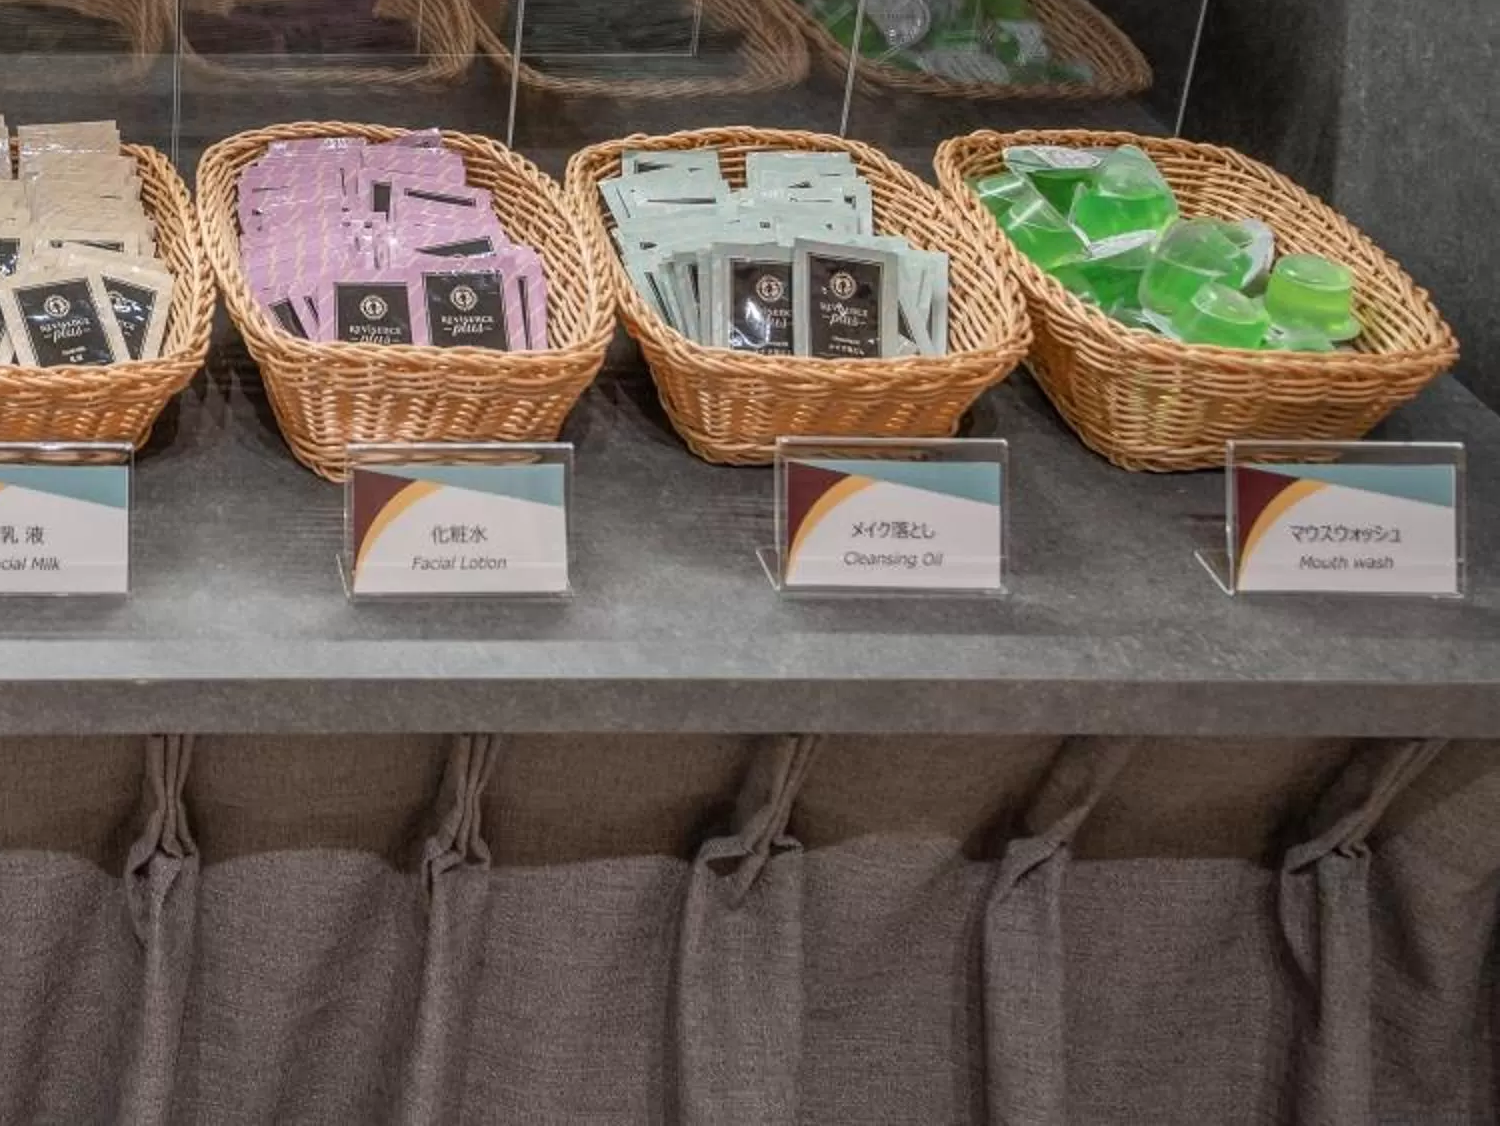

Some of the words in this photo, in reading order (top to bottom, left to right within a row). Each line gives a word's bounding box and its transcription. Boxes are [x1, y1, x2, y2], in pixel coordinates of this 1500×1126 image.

[431, 525, 489, 544] 化粧水
[851, 521, 937, 539] メイク落とし
[1289, 523, 1402, 544] マウスウォッシュ
[30, 556, 61, 570] Milk
[411, 556, 456, 571] Facial
[459, 556, 507, 570] Lotion
[843, 551, 918, 569] Cleansing
[922, 551, 944, 565] Oil
[1298, 555, 1348, 570] Mouth
[1352, 555, 1394, 570] wash
